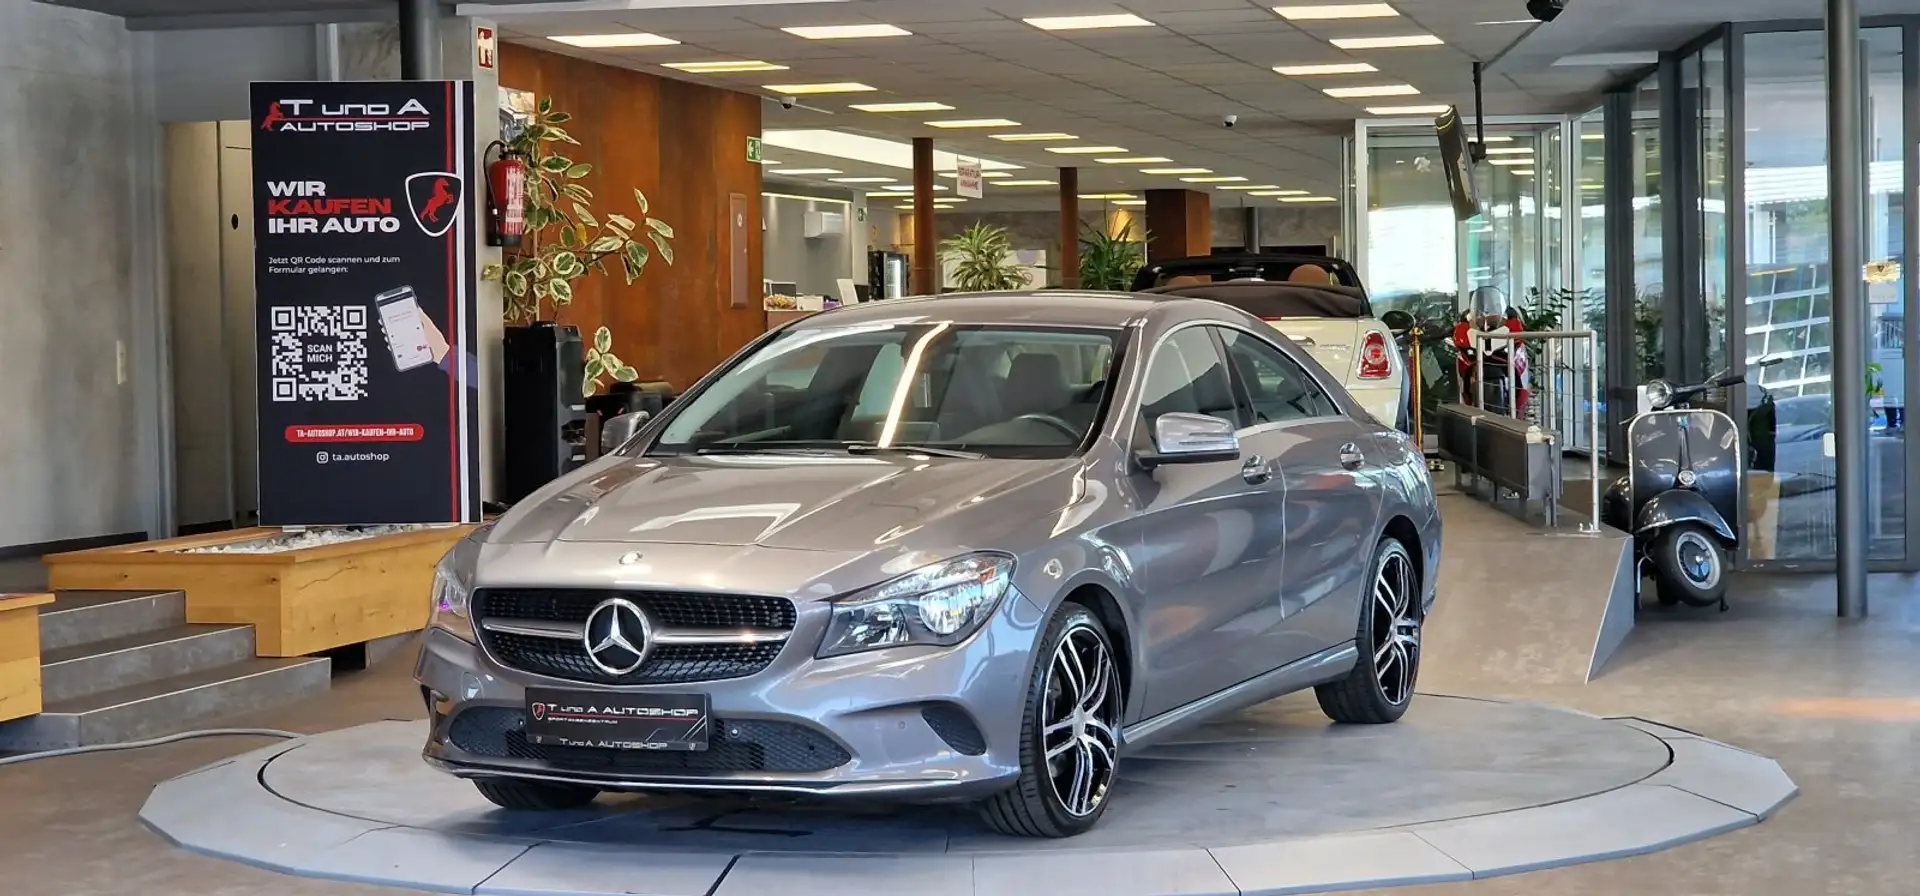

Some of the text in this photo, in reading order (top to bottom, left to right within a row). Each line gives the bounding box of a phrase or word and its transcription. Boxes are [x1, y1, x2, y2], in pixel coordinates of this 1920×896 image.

[280, 99, 313, 115] T
[396, 99, 429, 115] A
[280, 121, 430, 131] AUTOSHOP
[267, 181, 326, 197] WIR
[268, 198, 391, 215] KAUFEN
[268, 217, 400, 233] IHR AUTO
[268, 256, 289, 264] Jetzt
[290, 256, 303, 265] QR
[304, 256, 326, 264] Code
[364, 255, 380, 263] und
[268, 265, 348, 275] Formular gelangen:
[307, 344, 333, 353] SCAN
[307, 354, 333, 363] MICH
[332, 453, 389, 461] ta.autoshop
[547, 704, 558, 712] T
[587, 706, 598, 714] A
[602, 706, 699, 716] AUTOSHOP
[559, 738, 569, 746] T
[585, 739, 594, 747] A
[598, 741, 668, 750] AUTOSHOP
